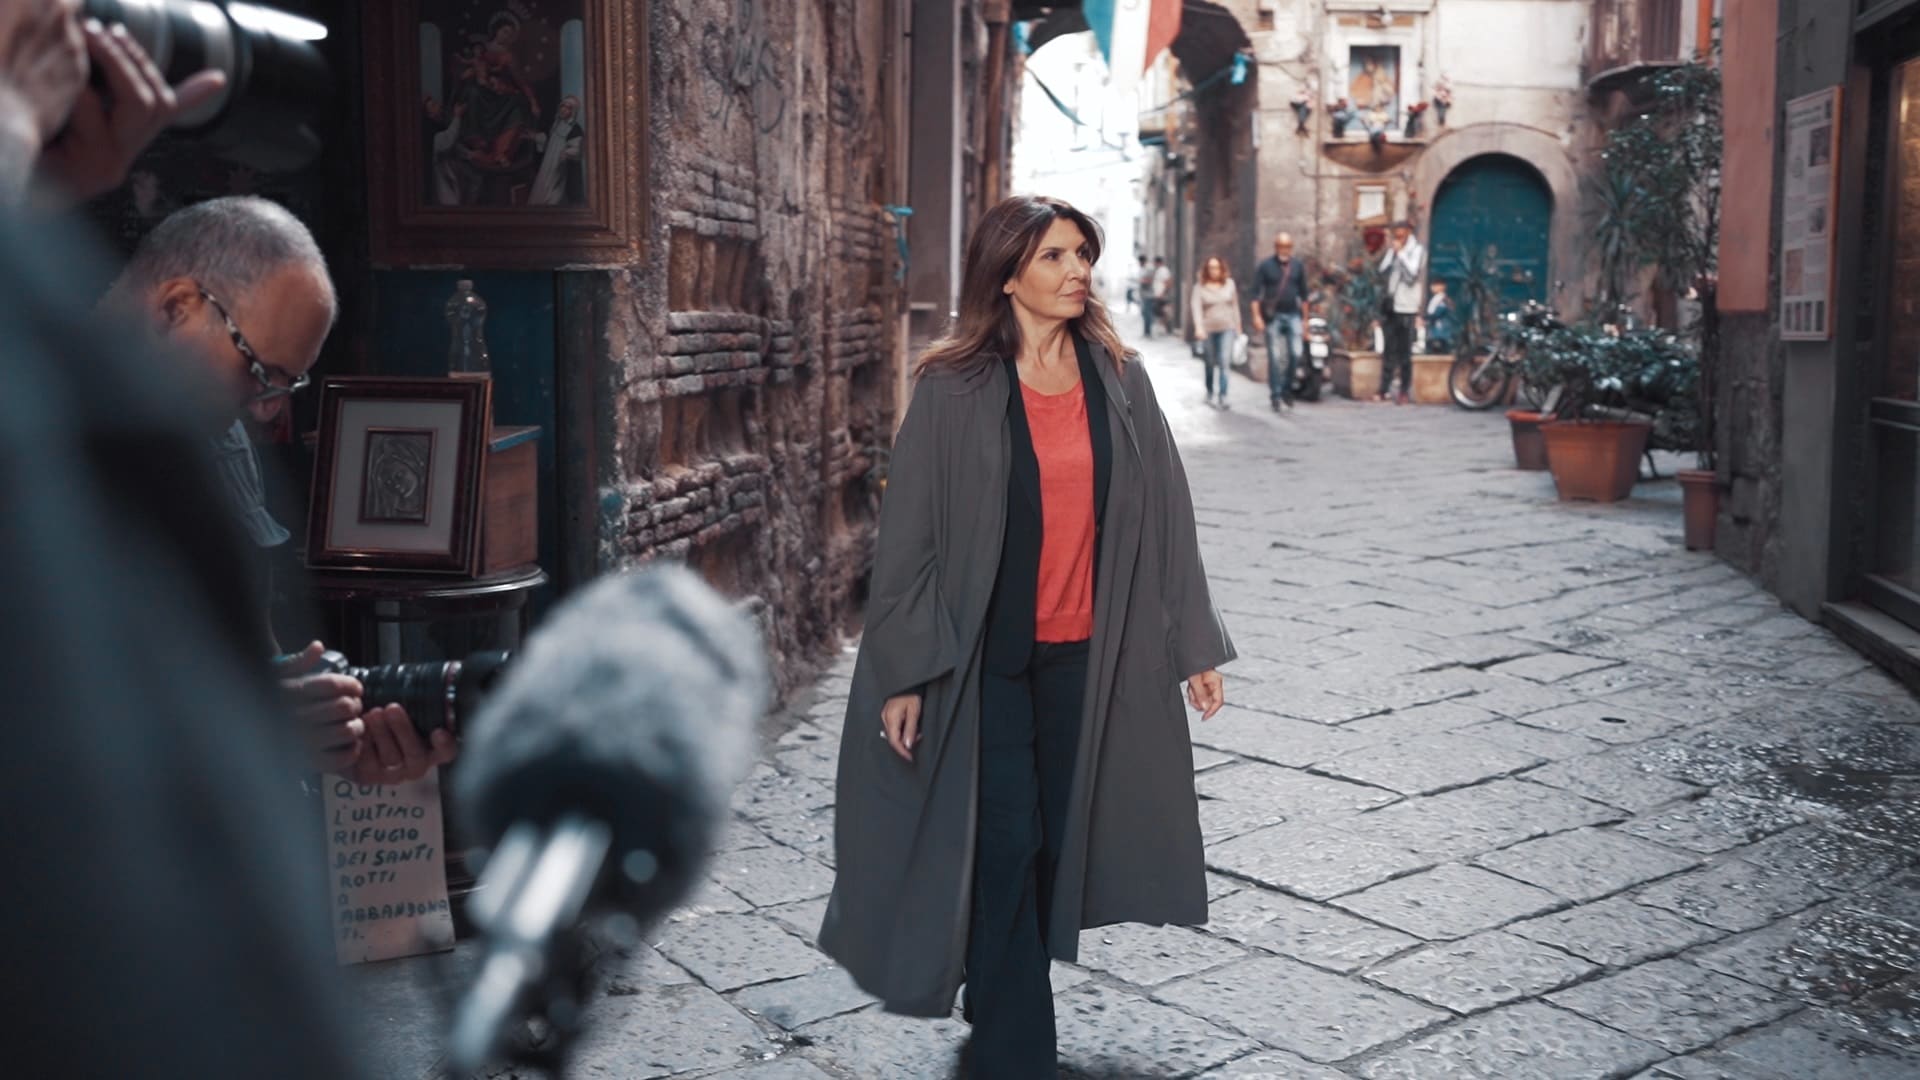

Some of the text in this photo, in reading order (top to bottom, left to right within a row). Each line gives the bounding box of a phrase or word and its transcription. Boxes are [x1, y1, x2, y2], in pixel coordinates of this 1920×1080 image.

[334, 827, 419, 845] RIFUGIO
[334, 843, 435, 868] DEI SANTI
[340, 870, 396, 888] ROTTI
